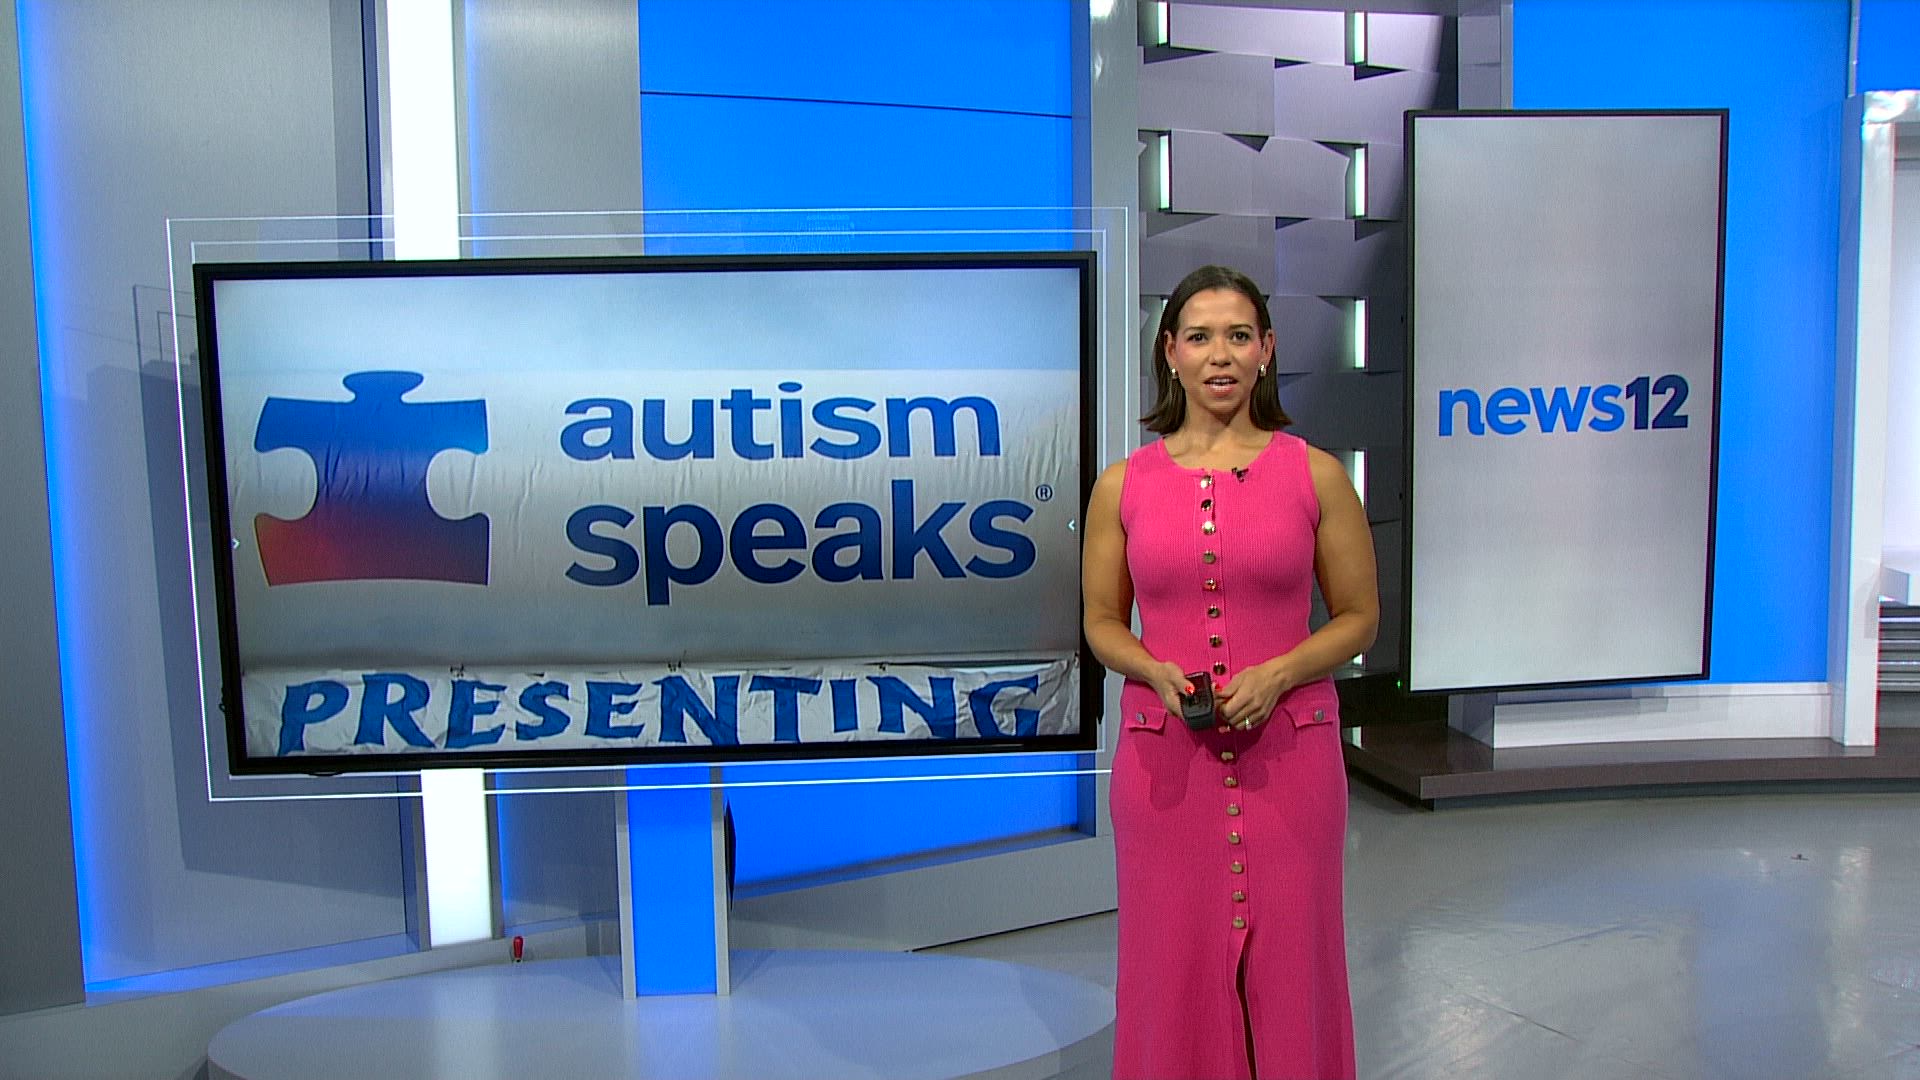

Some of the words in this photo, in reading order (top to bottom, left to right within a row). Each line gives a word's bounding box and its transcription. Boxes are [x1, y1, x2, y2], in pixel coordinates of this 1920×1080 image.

[559, 382, 1002, 461] autism
[1438, 374, 1689, 437] news12
[278, 673, 1040, 756] PRESENTING
